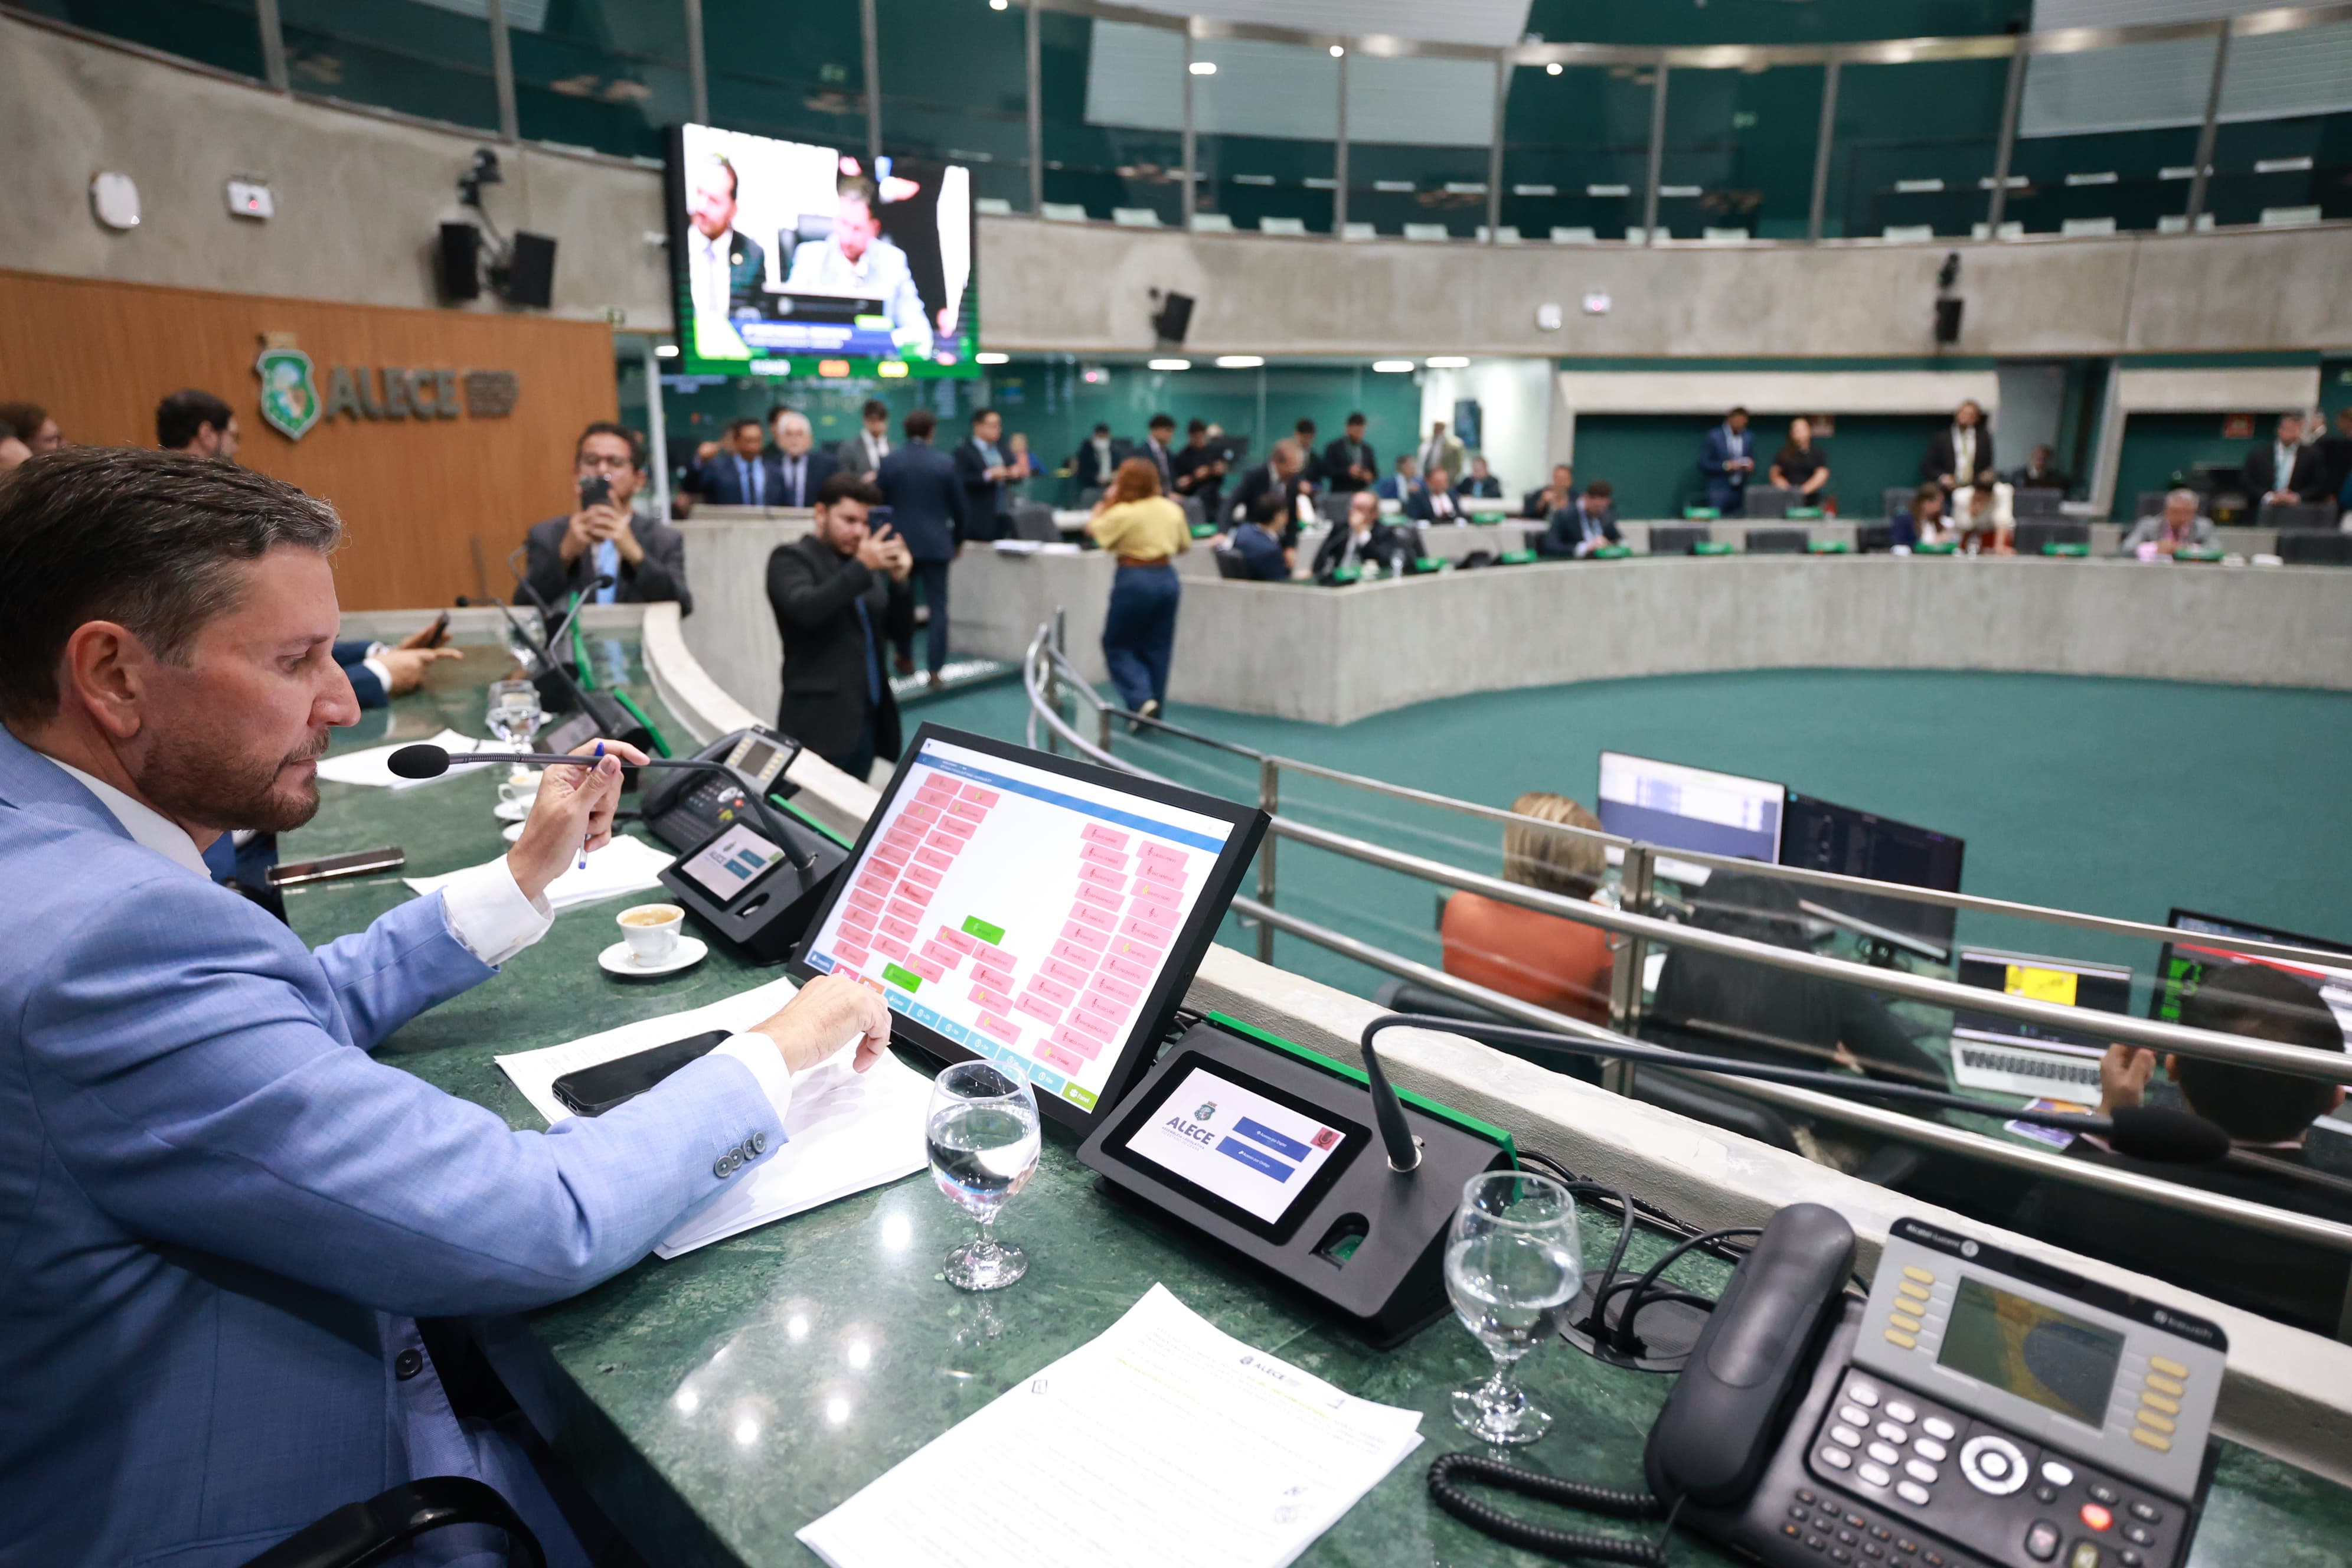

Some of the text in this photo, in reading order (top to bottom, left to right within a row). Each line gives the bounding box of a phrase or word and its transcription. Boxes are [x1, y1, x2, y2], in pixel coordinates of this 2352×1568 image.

[326, 365, 461, 416] ALECE
[1166, 1116, 1216, 1145] ALECE
[1255, 1363, 1285, 1380] ALECE
